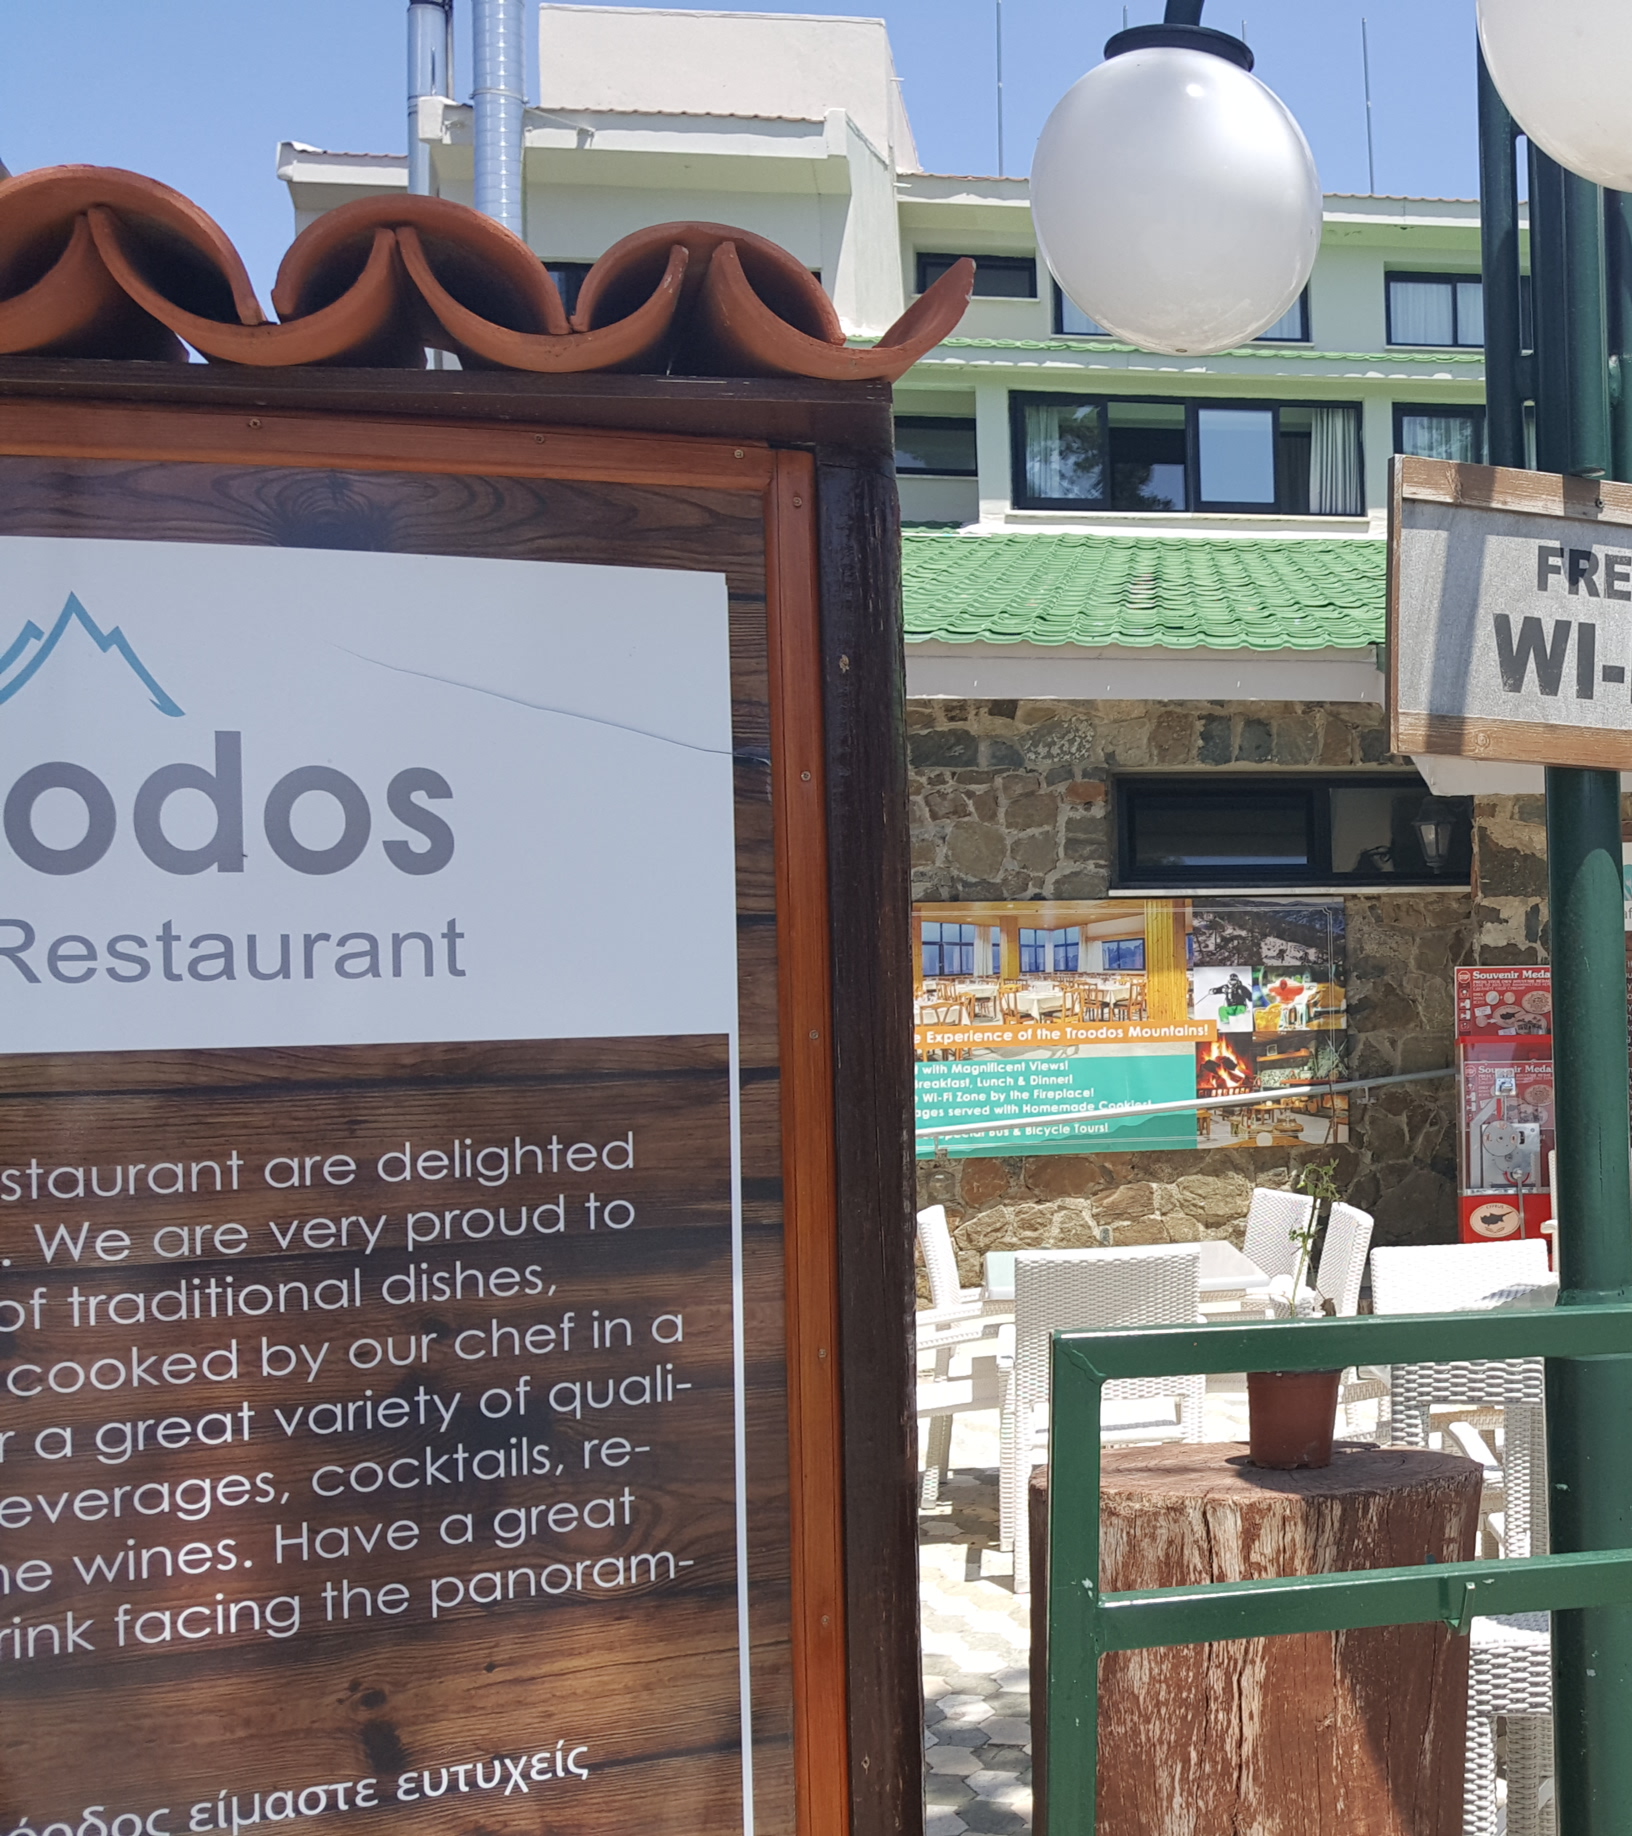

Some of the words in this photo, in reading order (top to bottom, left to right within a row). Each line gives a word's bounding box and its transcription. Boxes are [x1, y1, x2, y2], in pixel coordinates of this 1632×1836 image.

[0, 917, 467, 984] Restaurant
[1473, 970, 1519, 980] Souvenir
[922, 1064, 948, 1074] with
[952, 1060, 1026, 1075] Magnificent
[1030, 1060, 1068, 1072] Views!
[926, 1031, 1012, 1044] Experience
[1018, 1029, 1032, 1040] of
[1036, 1028, 1060, 1040] the
[1066, 1026, 1124, 1039] Troodos
[1128, 1024, 1208, 1038] Mountains!
[922, 1092, 952, 1103] Wi-Fi
[956, 1092, 986, 1102] Zone
[990, 1090, 1006, 1103] by
[1010, 1089, 1030, 1100] the
[1034, 1088, 1094, 1100] Fireplace!
[948, 1106, 990, 1116] served
[994, 1104, 1018, 1114] with
[1022, 1102, 1094, 1114] Homemade
[977, 1076, 1014, 1087] Lunch
[1018, 1076, 1026, 1086] &
[1025, 1124, 1070, 1136] Bicycle
[1074, 1122, 1108, 1134] Tours!
[1, 1150, 243, 1201] staurant
[265, 1155, 356, 1188] are
[378, 1131, 633, 1186] delighted
[34, 1222, 131, 1263] We
[154, 1223, 248, 1257] are
[269, 1215, 386, 1254] very
[408, 1194, 564, 1251] proud
[585, 1193, 634, 1229] to
[0, 1287, 46, 1332] of
[67, 1268, 360, 1326] traditional
[382, 1261, 556, 1304] dishes,
[7, 1339, 237, 1396] cooked
[262, 1337, 329, 1382] by
[349, 1333, 434, 1368] our
[455, 1312, 574, 1359] chef
[593, 1310, 631, 1348] in
[652, 1315, 682, 1343] a
[35, 1428, 71, 1459] a
[96, 1402, 255, 1464] great
[274, 1386, 461, 1436] variety
[480, 1376, 530, 1418] of
[549, 1364, 691, 1419] quali-
[312, 1437, 563, 1496] cocktails,
[584, 1438, 650, 1468] re-
[73, 1539, 252, 1584] wines.
[276, 1520, 419, 1563] Have
[440, 1514, 472, 1544] a
[494, 1487, 635, 1548] great
[115, 1593, 299, 1646] facing
[322, 1580, 409, 1620] the
[432, 1552, 693, 1618] panoram-
[190, 1779, 378, 1836] είμαστε
[397, 1740, 588, 1800] ευτυχείς
